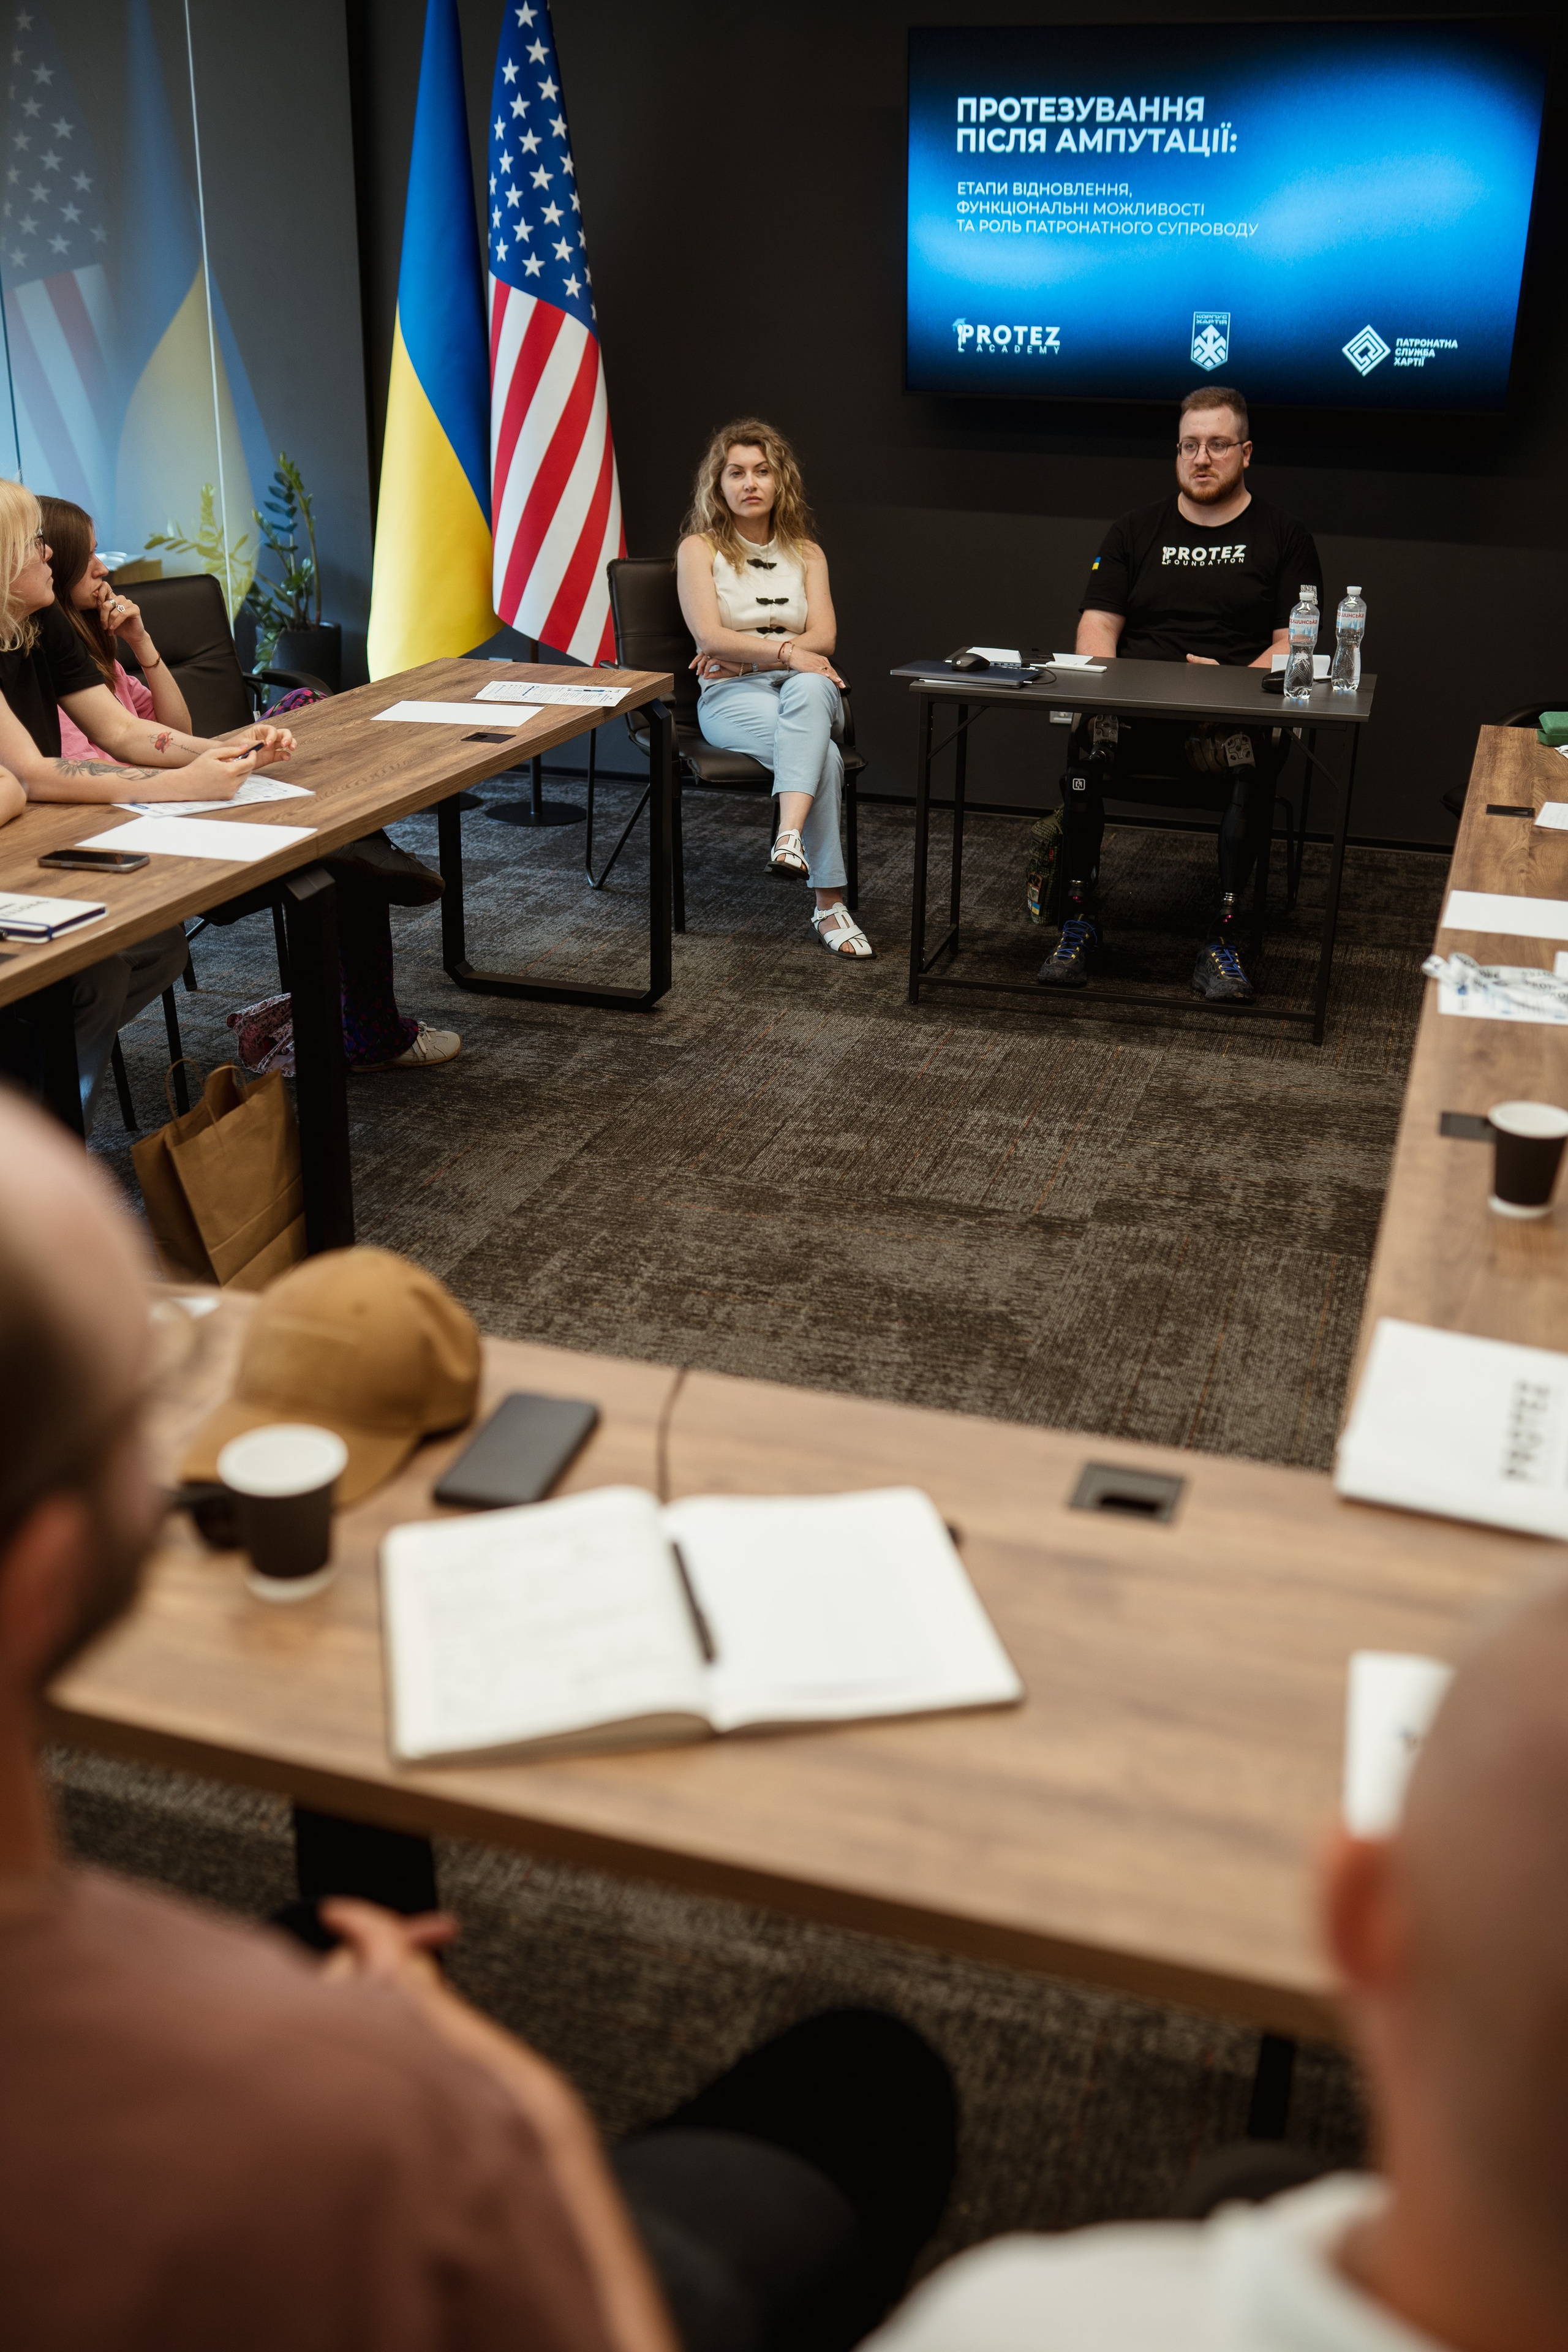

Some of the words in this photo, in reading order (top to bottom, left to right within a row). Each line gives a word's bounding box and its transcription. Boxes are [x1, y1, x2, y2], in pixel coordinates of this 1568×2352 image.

[957, 97, 1205, 123] ПРОТЕЗУВАННЯ
[956, 127, 1047, 153] ПІСЛЯ
[1055, 122, 1238, 157] АМПУТАЦІЇ:
[957, 181, 1008, 195] ЕТАПИ
[1012, 181, 1133, 198] ВІДНОВЛЕННЯ,
[956, 200, 1088, 216] ФУНКЦІОНАЛЬНІ
[1093, 202, 1205, 216] МОЖЛИВОСТІ
[956, 219, 975, 232] ТА
[979, 219, 1022, 233] РОЛЬ
[1025, 220, 1153, 235] ПАТРОНАТНОГО
[1157, 222, 1259, 238] СУПРОВОДУ
[961, 324, 1061, 346] PROTEZ
[976, 344, 1060, 355] ACADEMY
[1396, 338, 1458, 349] ПАТРОНАТНА
[1394, 347, 1436, 358] СЛУЖБА
[1393, 356, 1426, 368] ХАРТІЇ
[1166, 544, 1247, 561] PROTEZ
[1166, 557, 1245, 567] FOUNDATION
